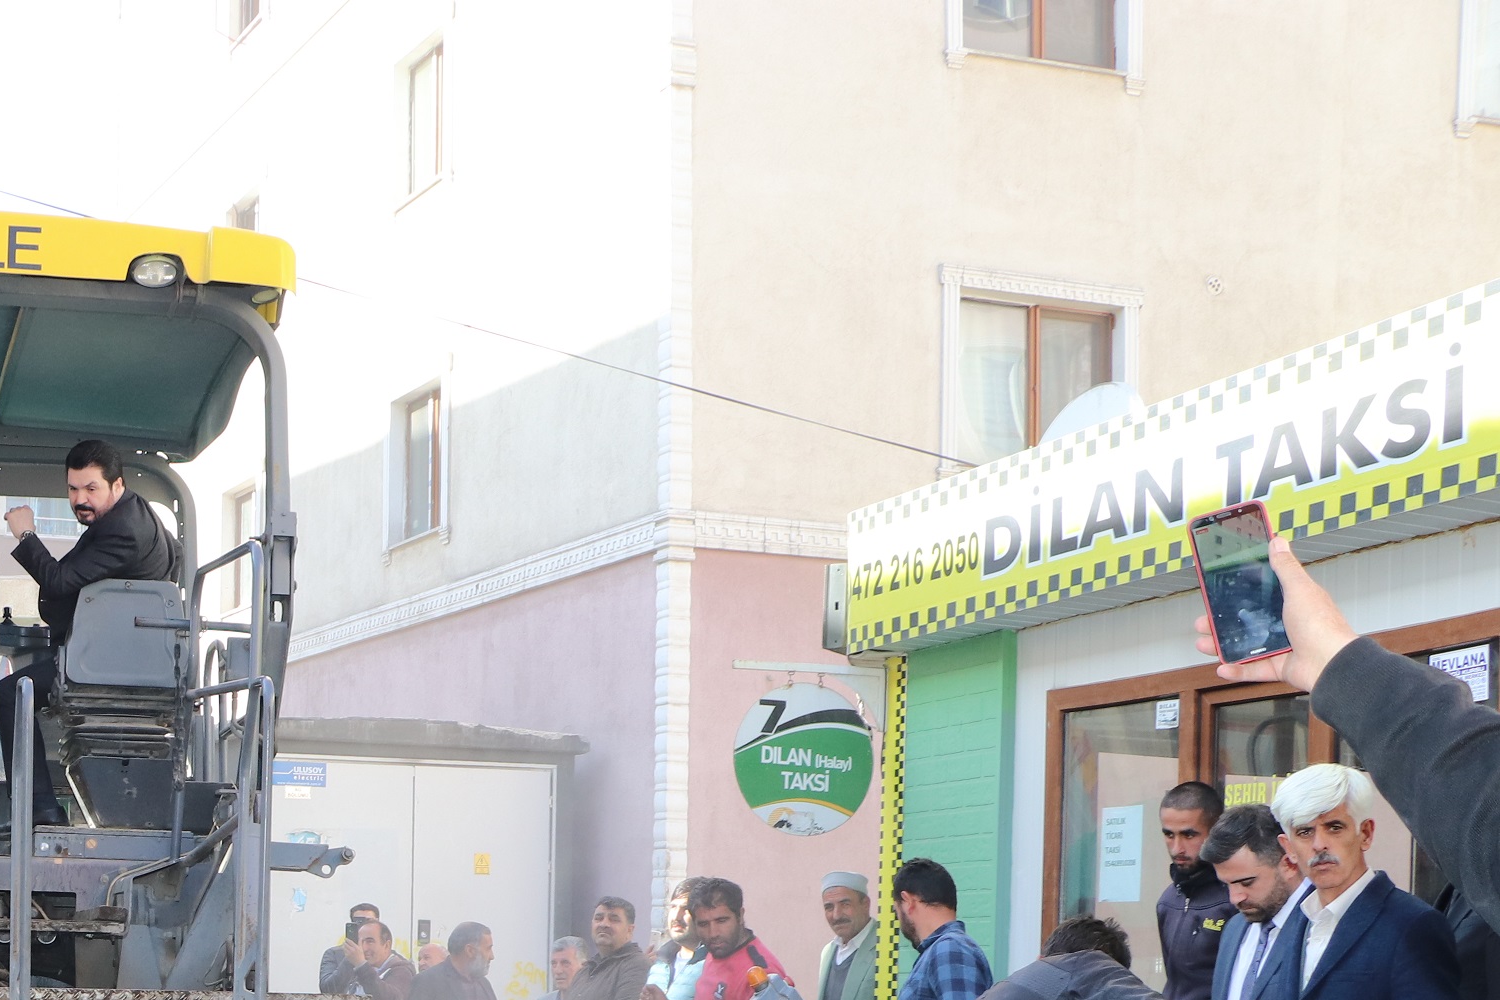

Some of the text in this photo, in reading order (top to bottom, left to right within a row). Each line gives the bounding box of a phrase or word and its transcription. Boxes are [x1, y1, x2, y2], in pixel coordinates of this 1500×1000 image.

[984, 342, 1464, 577] DİLAN TAKSİ
[847, 531, 979, 601] 472 216 2050
[759, 698, 787, 734] 7
[293, 766, 323, 774] ULUSOY
[760, 745, 853, 773] DILAN (Halay)
[781, 770, 830, 792] TAKSİ
